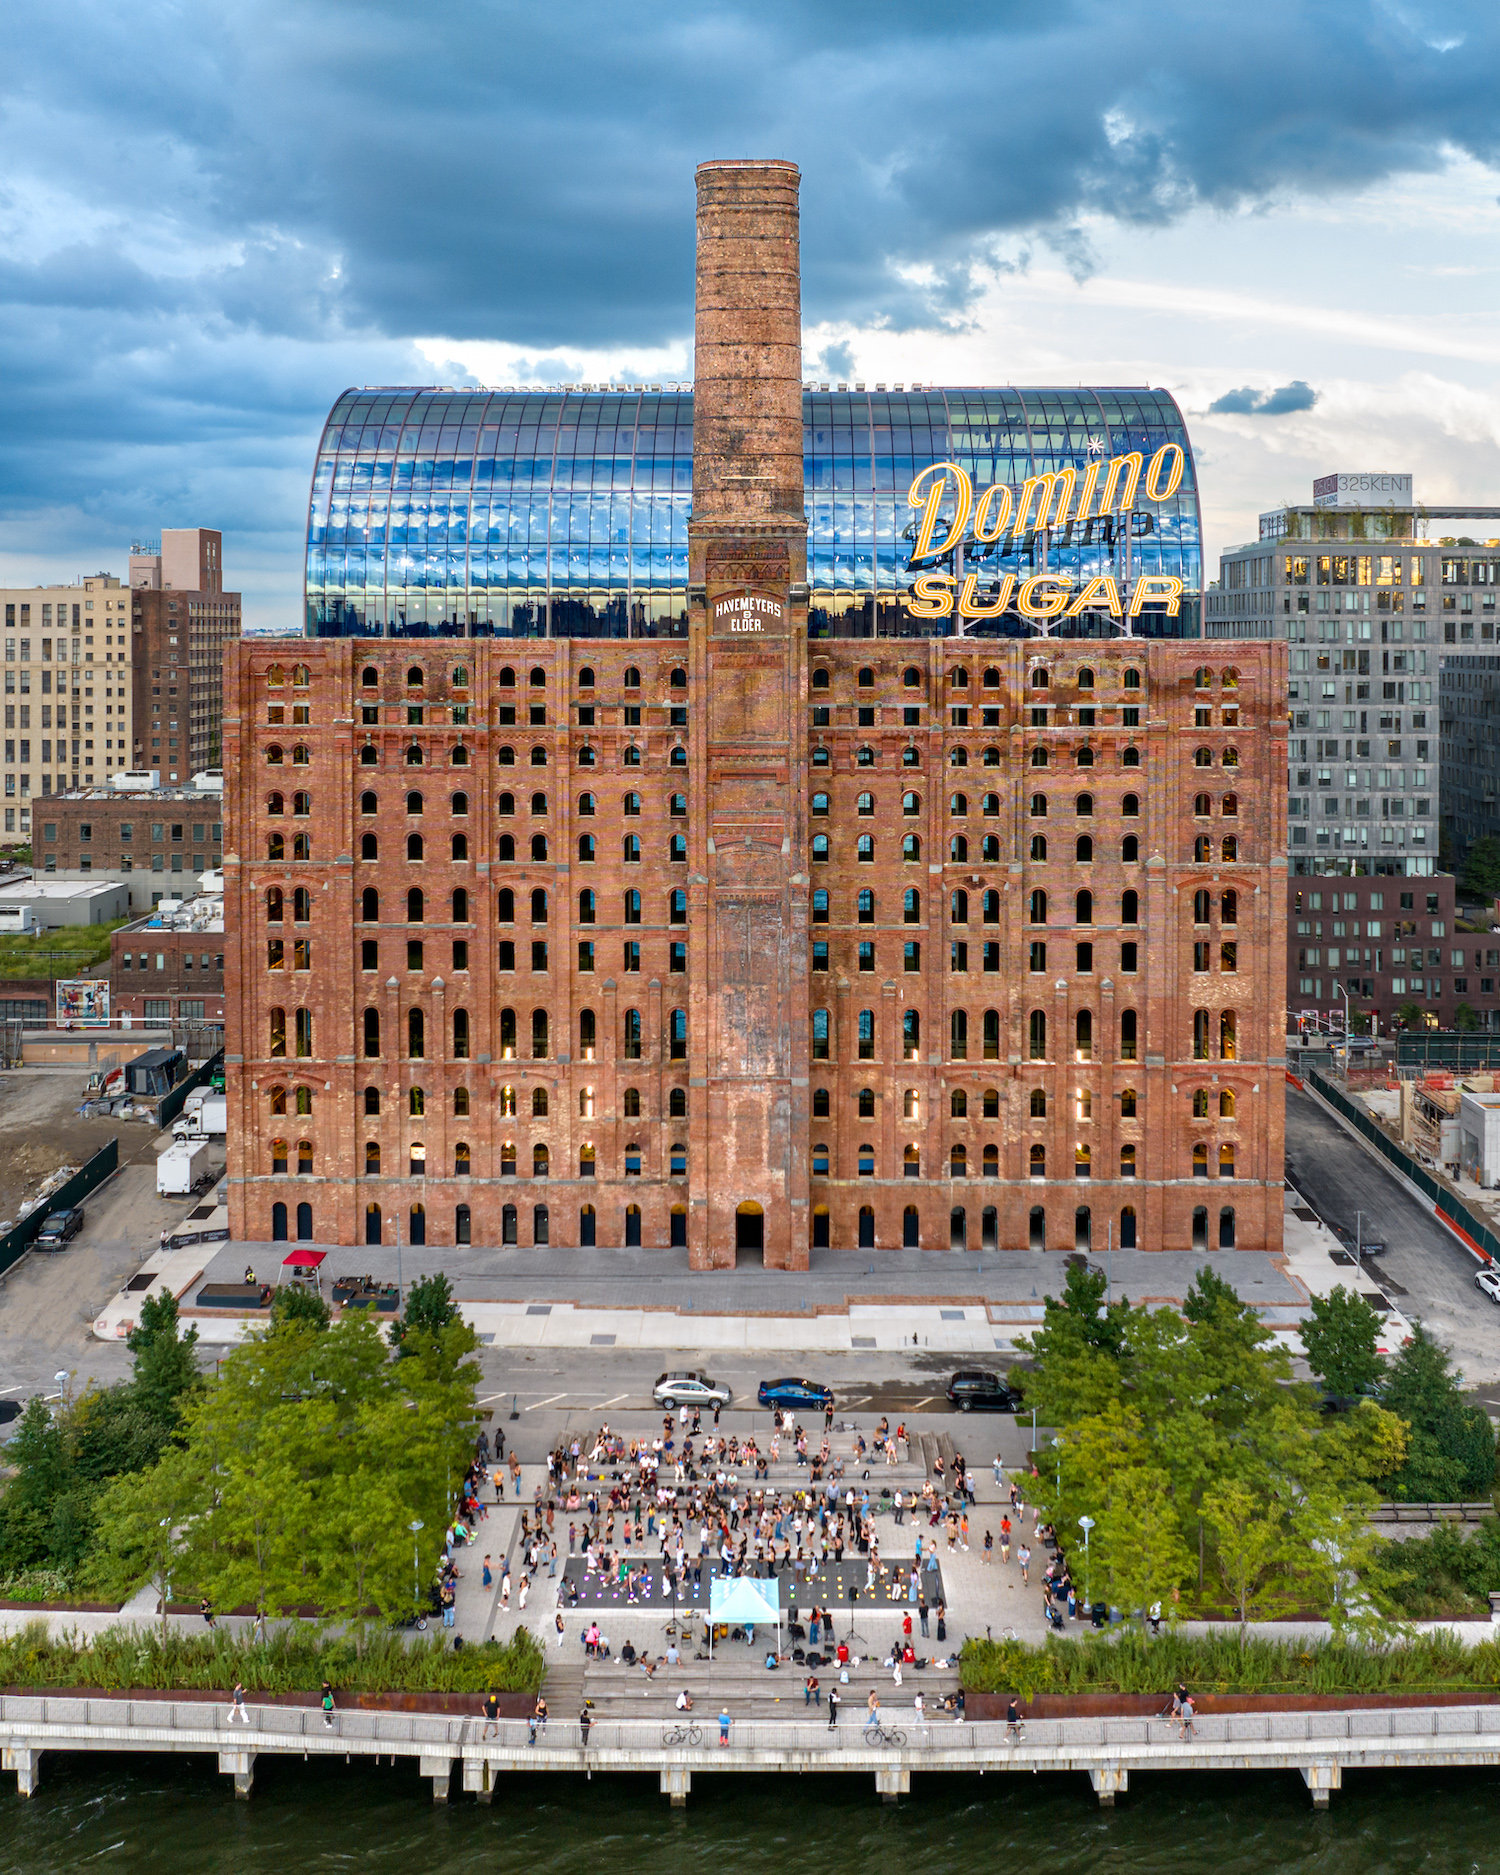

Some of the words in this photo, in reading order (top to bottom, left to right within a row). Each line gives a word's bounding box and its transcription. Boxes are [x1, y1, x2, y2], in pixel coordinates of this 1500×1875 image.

[1338, 476, 1412, 492] 325KENT
[907, 438, 1185, 562] Domino
[907, 573, 1184, 618] SUGAR
[716, 597, 781, 617] HAVEMEYERS
[743, 610, 752, 619] &
